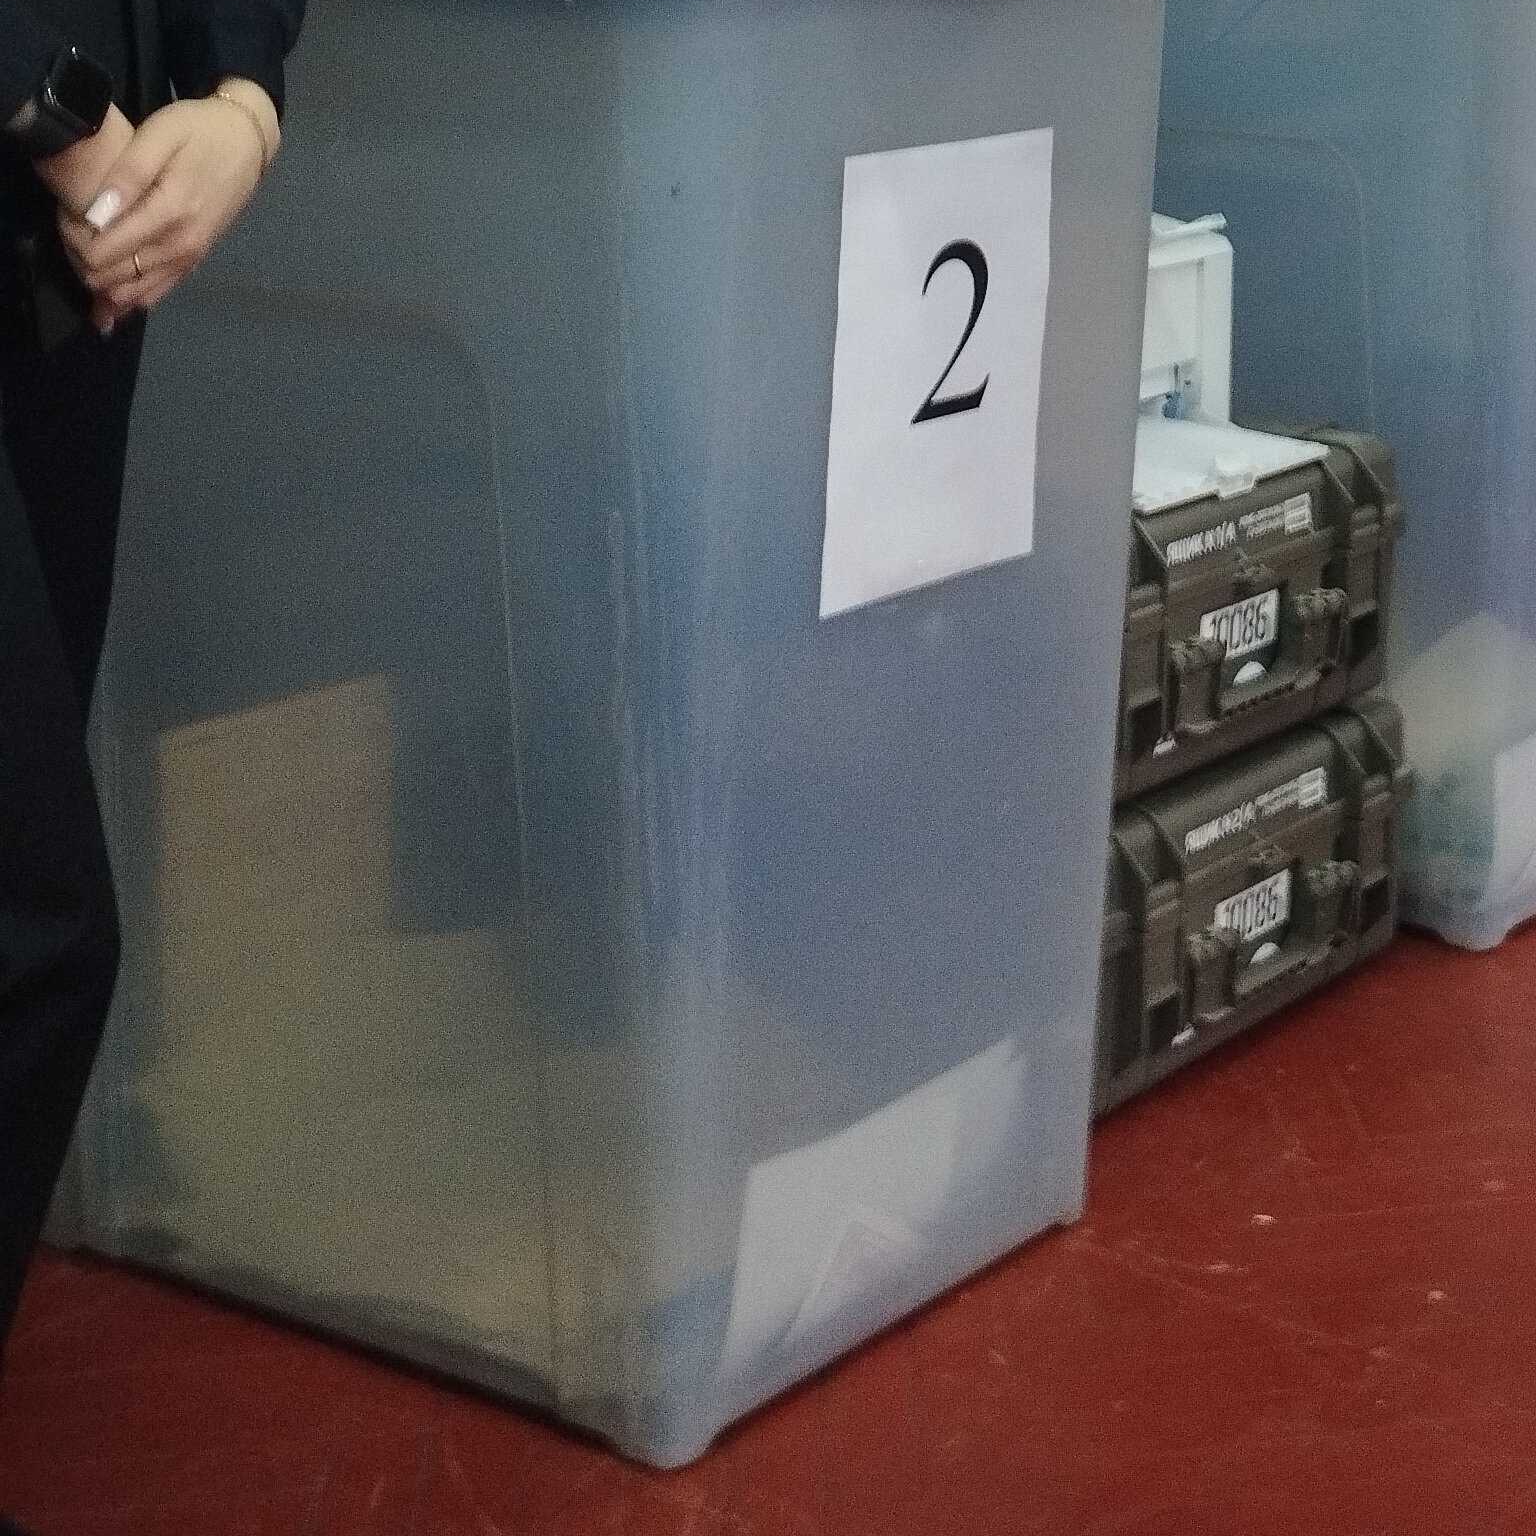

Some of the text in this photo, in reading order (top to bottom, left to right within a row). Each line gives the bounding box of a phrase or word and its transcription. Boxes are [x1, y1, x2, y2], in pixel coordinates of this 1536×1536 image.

[911, 238, 990, 424] 2
[1210, 594, 1268, 649] 10086
[1223, 876, 1280, 934] 10086
